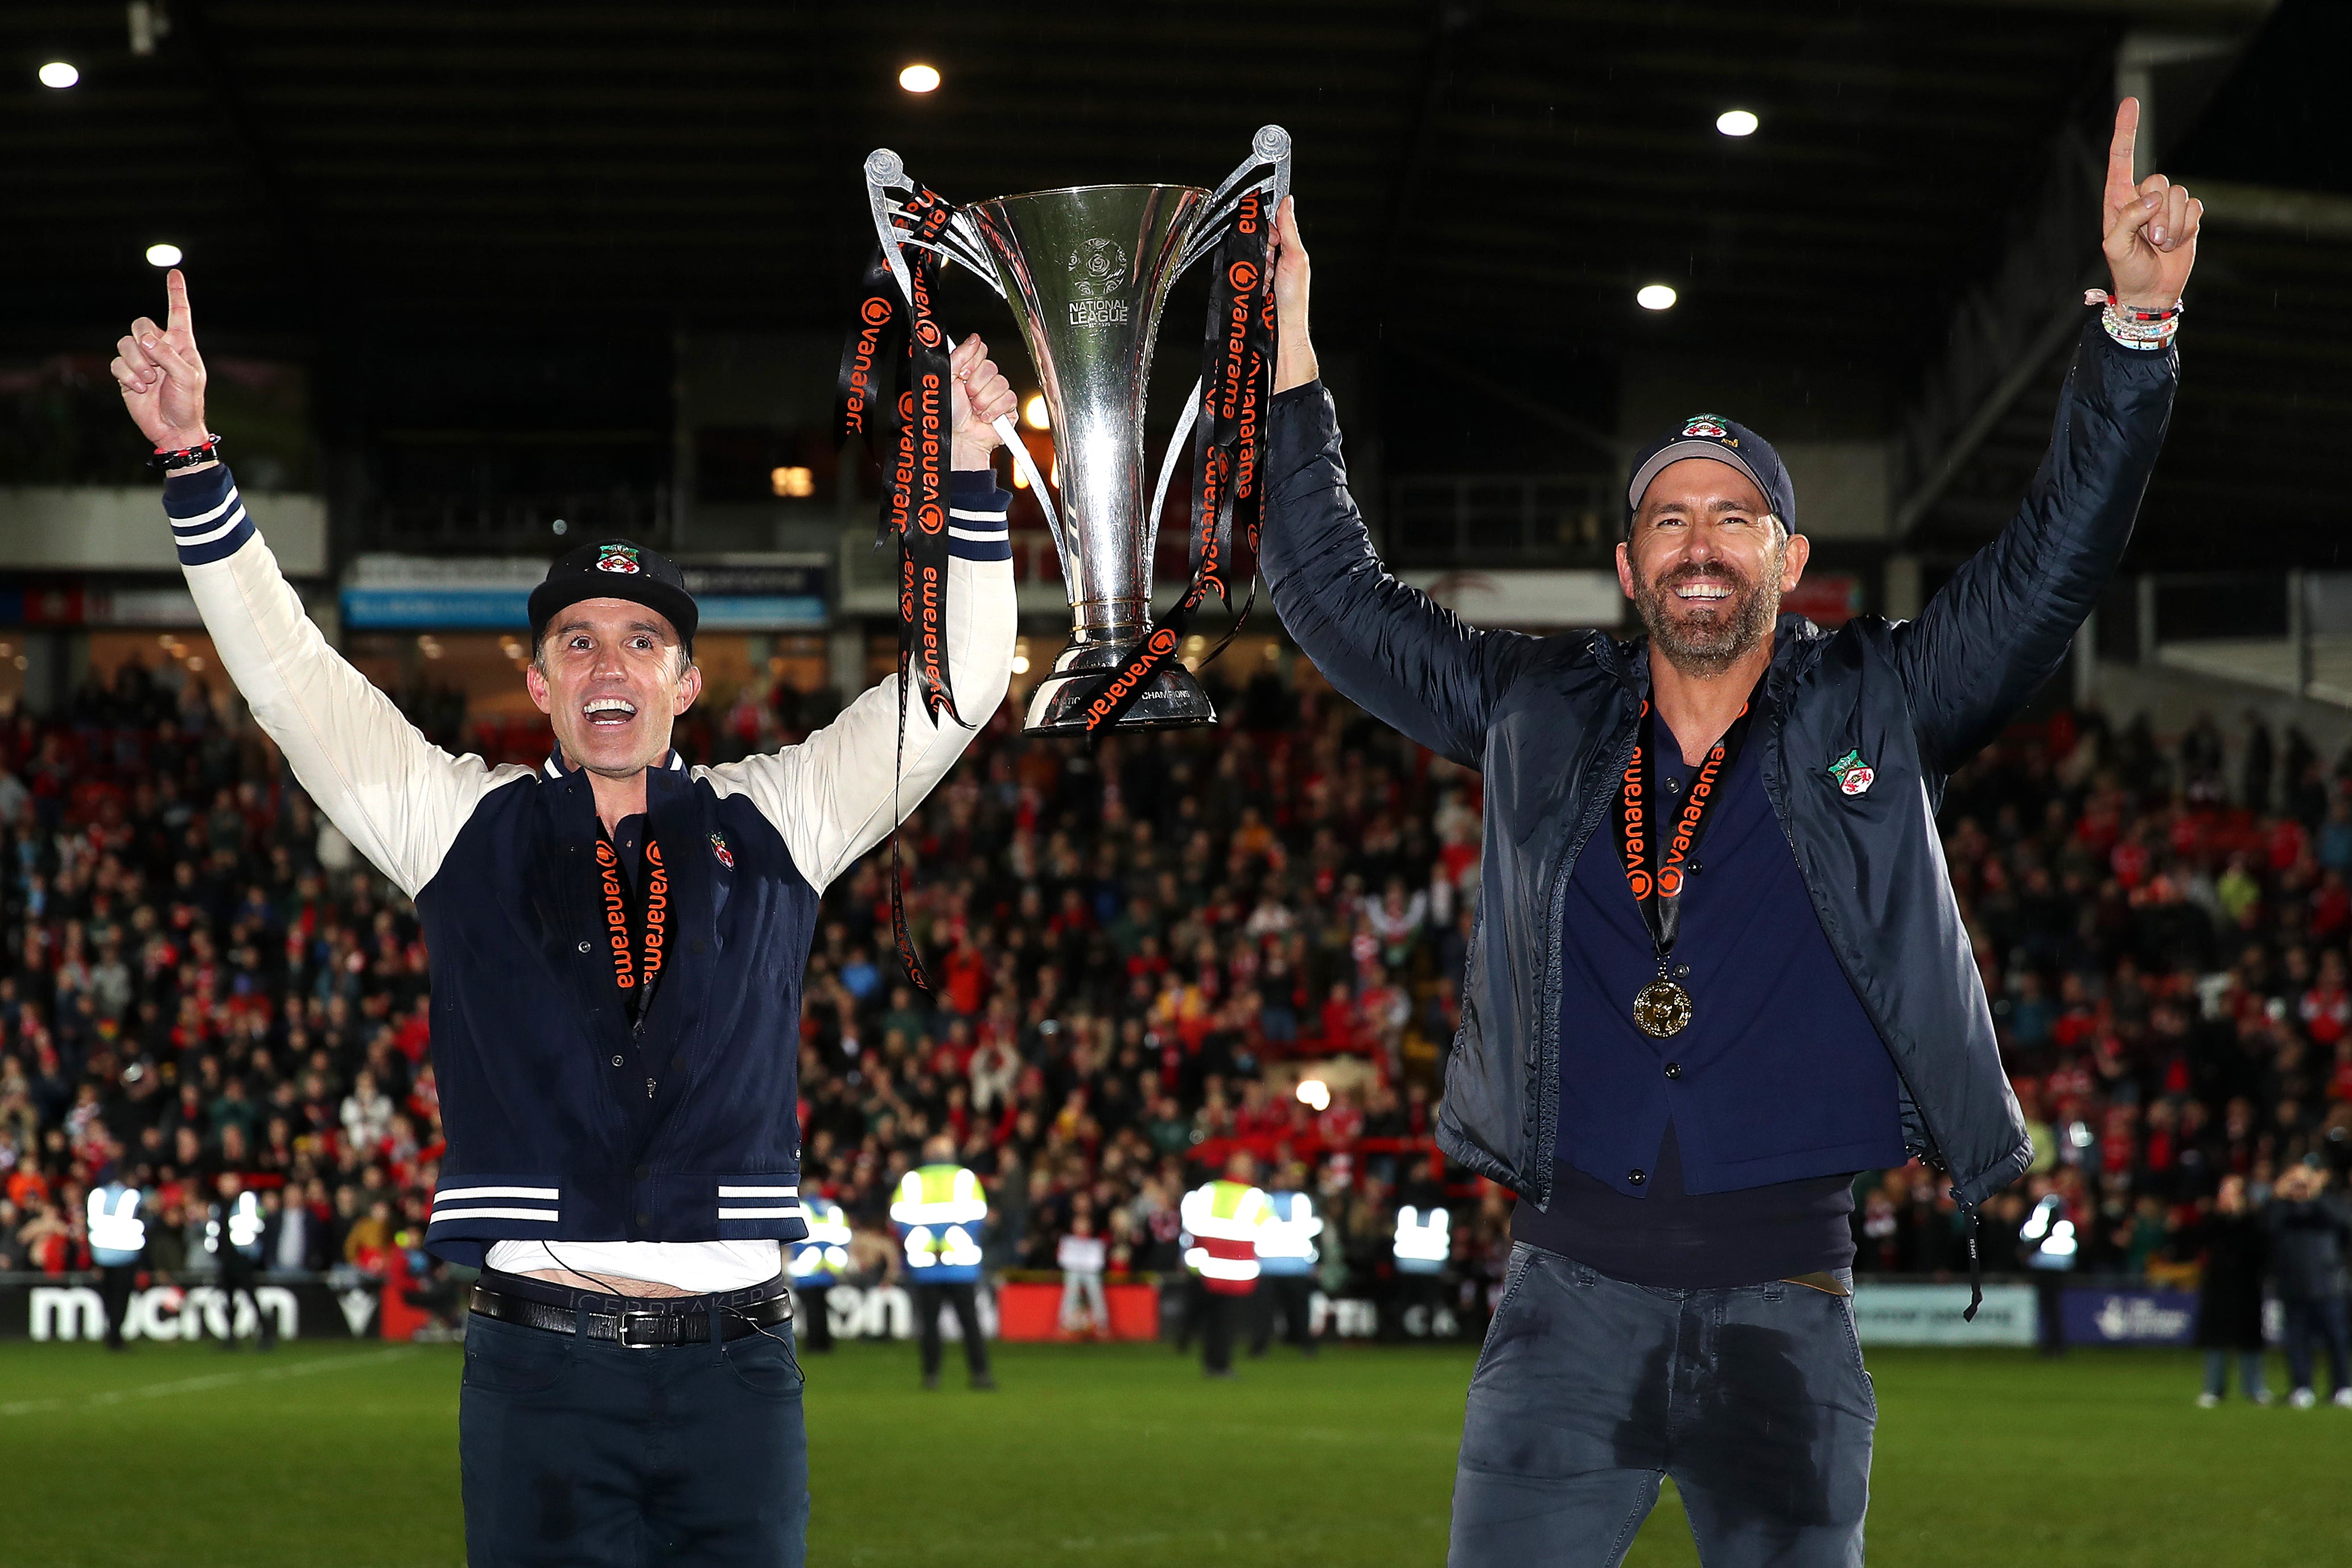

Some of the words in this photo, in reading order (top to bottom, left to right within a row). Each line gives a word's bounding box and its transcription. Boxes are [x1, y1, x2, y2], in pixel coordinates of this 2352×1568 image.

[1069, 299, 1127, 313] NATIONAL
[1069, 308, 1127, 325] LEAGUE
[1222, 294, 1250, 419] vanarama
[922, 374, 940, 501] vanarama
[923, 566, 942, 692] vanarama
[1056, 696, 1082, 706] NATIO
[1142, 690, 1191, 700] CHAMPIONS
[1666, 747, 1725, 863] vanarama
[602, 869, 635, 988] vanarama
